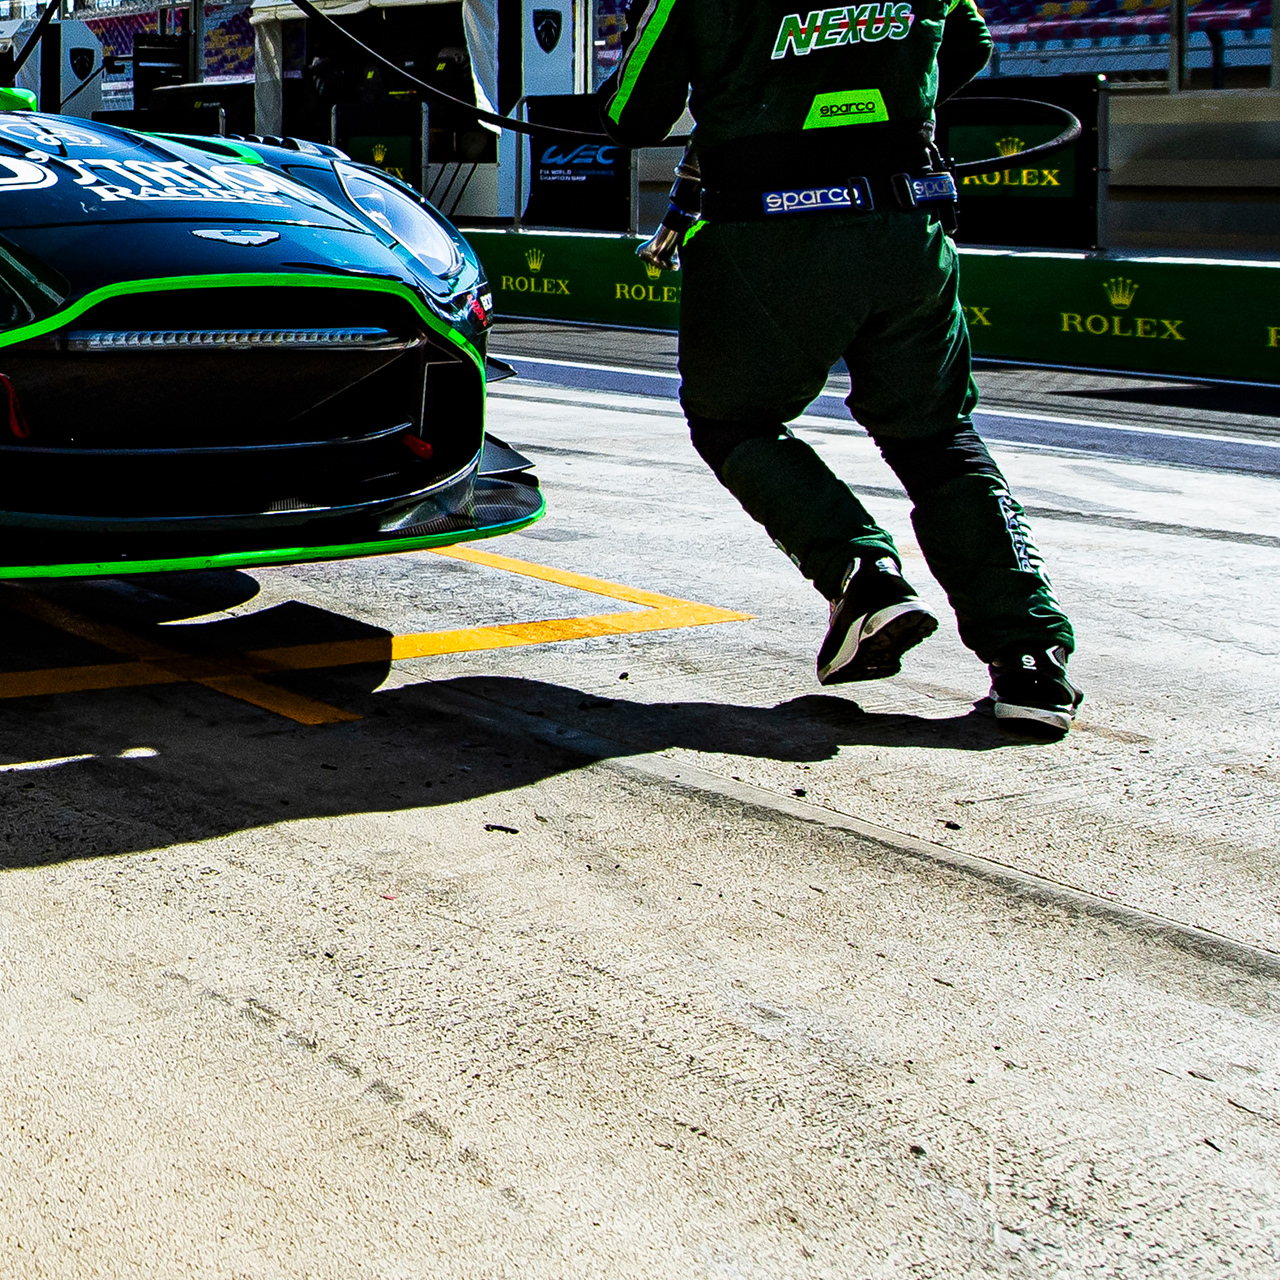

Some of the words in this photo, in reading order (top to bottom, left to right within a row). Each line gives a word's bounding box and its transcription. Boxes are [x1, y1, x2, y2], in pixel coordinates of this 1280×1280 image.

[770, 2, 915, 61] NEXUS
[819, 101, 876, 117] sparco
[541, 144, 619, 165] WEC
[83, 184, 291, 207] RACING
[501, 275, 571, 295] ROLEX
[615, 283, 681, 303] ROLE
[1060, 312, 1187, 340] ROLEX
